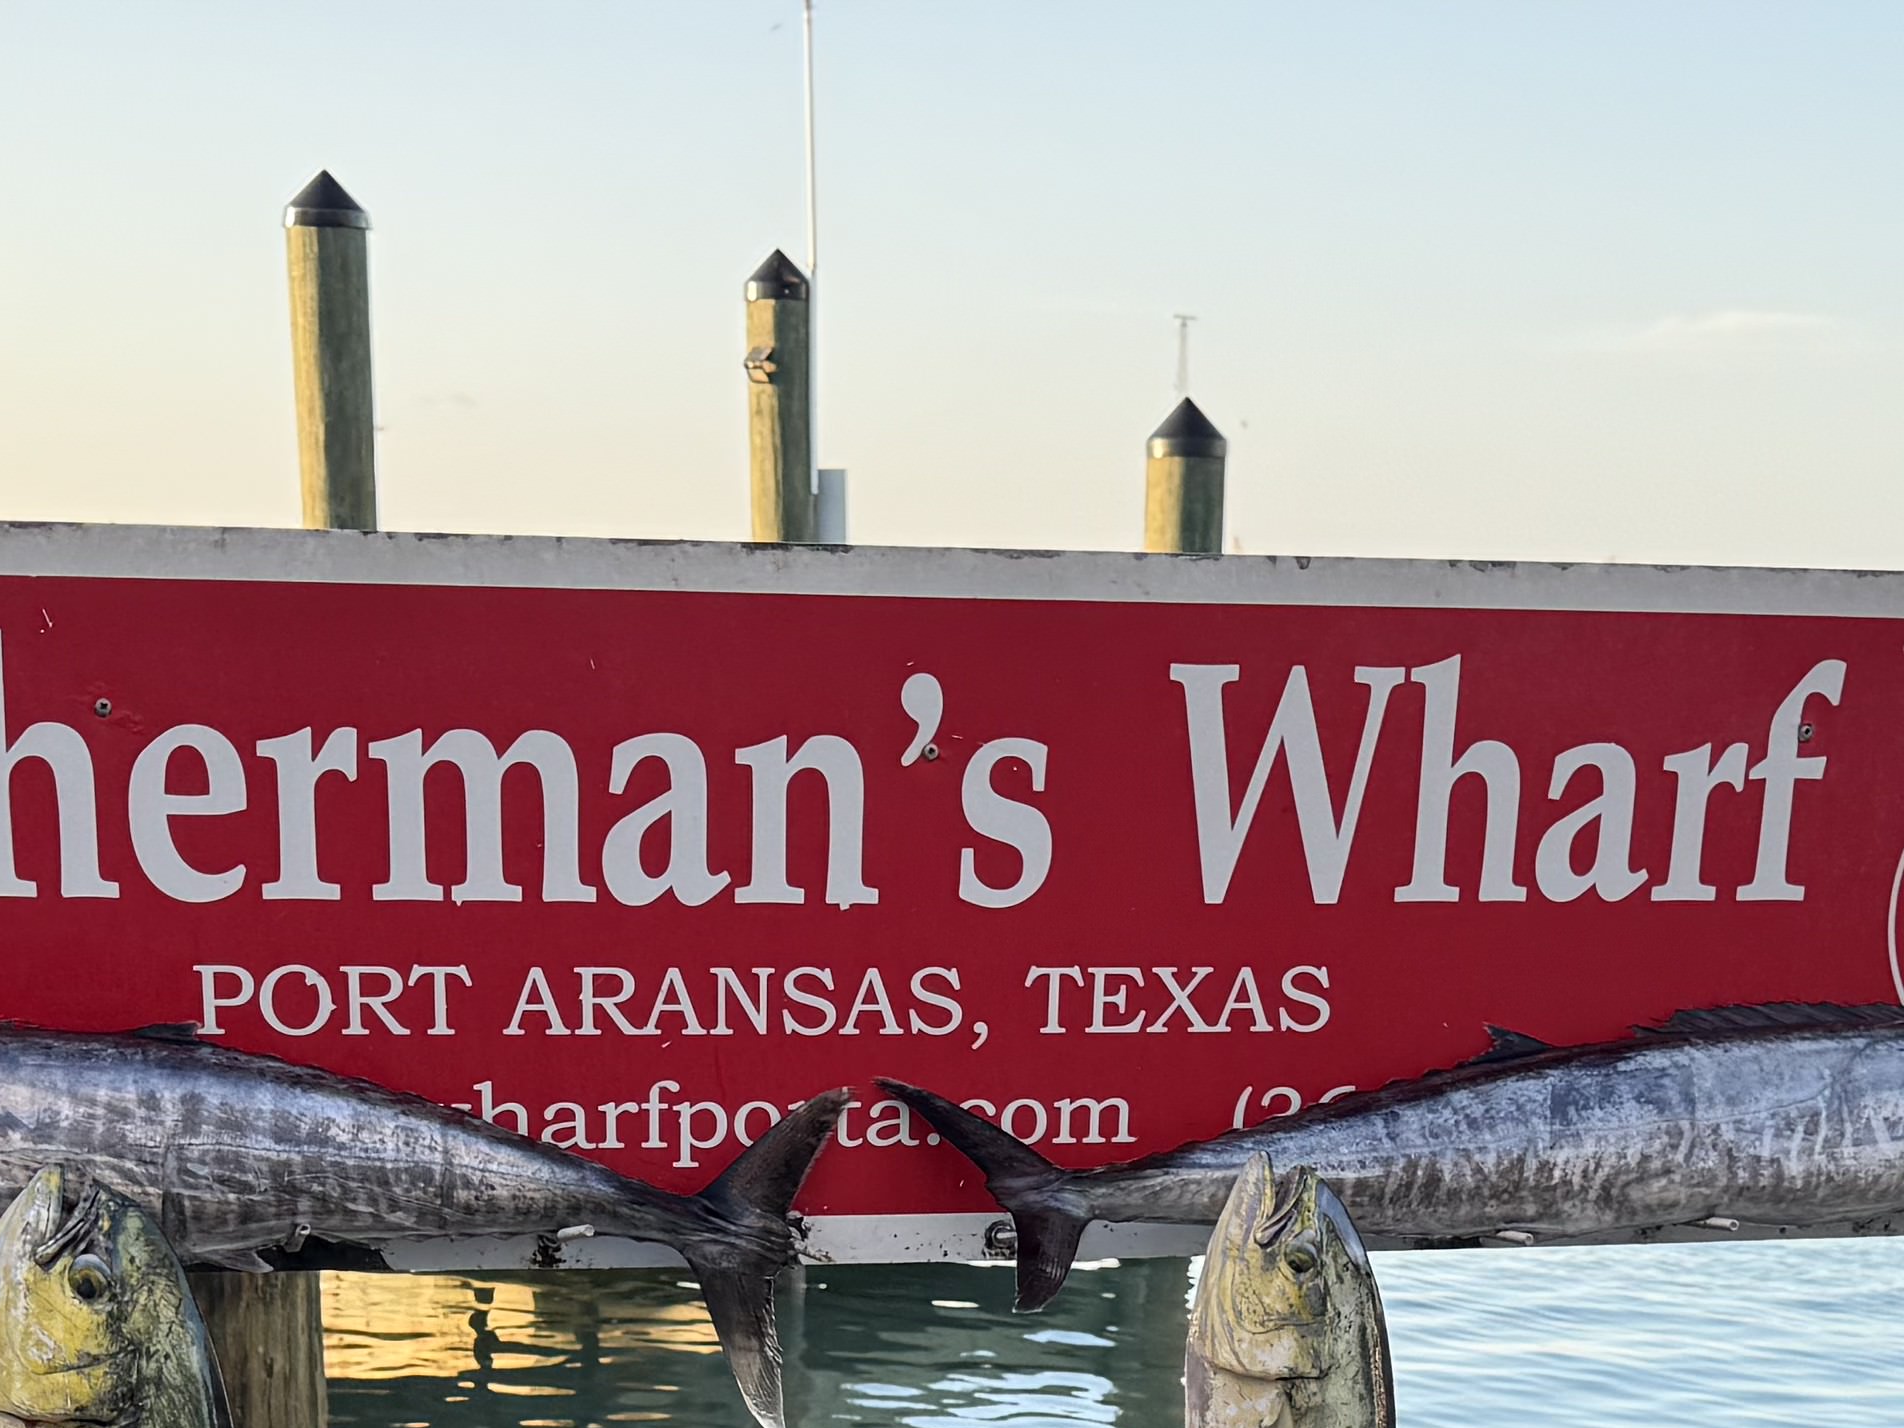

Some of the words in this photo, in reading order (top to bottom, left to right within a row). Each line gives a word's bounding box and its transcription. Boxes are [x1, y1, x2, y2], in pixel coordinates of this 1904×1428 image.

[1169, 653, 1847, 905] Wharf
[193, 963, 478, 1037] PORT
[502, 964, 990, 1050] ARANSAS,
[1024, 964, 1333, 1034] TEXAS
